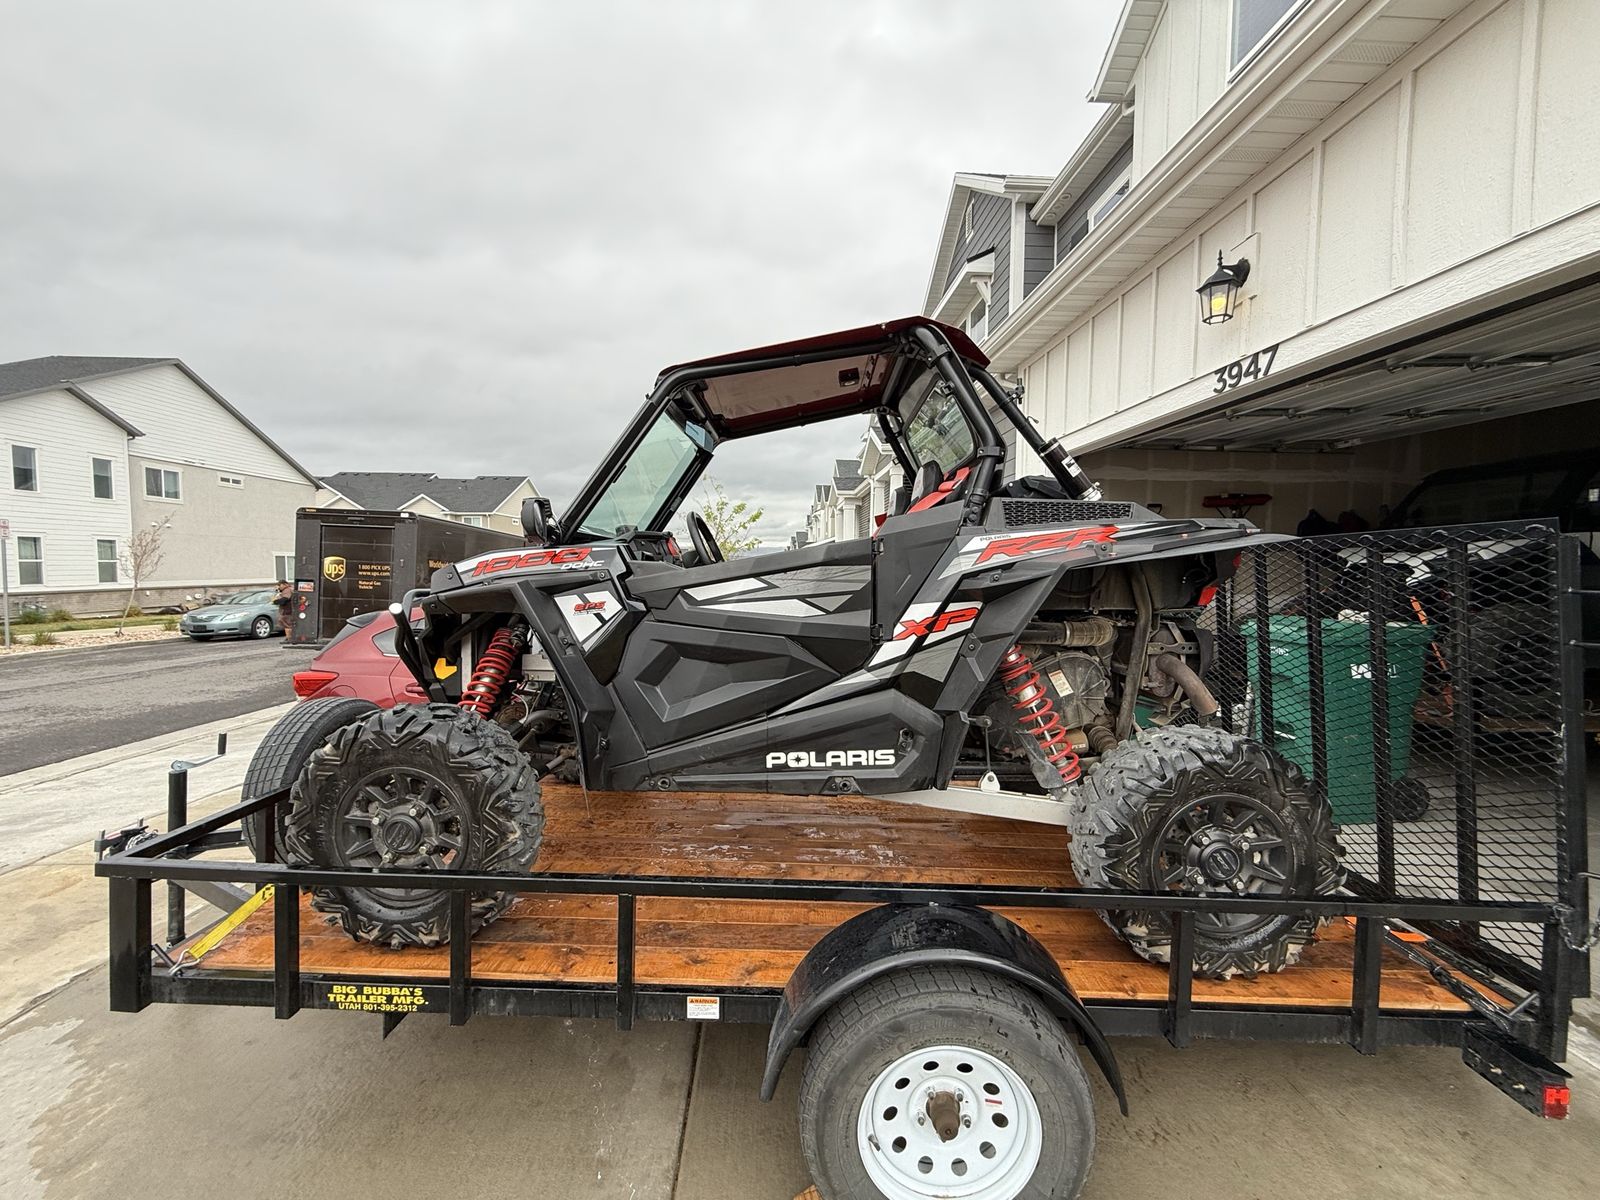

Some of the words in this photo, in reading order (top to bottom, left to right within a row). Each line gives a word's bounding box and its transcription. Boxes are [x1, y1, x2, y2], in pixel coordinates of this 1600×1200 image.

[1213, 343, 1280, 393] 3947
[975, 525, 1120, 565] RZR
[325, 563, 344, 577] ups
[471, 548, 592, 577] 1000
[560, 560, 605, 570] DOHC
[893, 608, 980, 641] XP
[765, 749, 896, 769] POLARIS
[333, 985, 358, 994] BIG
[363, 986, 423, 996] BUBBA'S
[327, 994, 387, 1004] TRAILER
[392, 996, 429, 1005] MFG.
[362, 1004, 418, 1012] 801-395-2312
